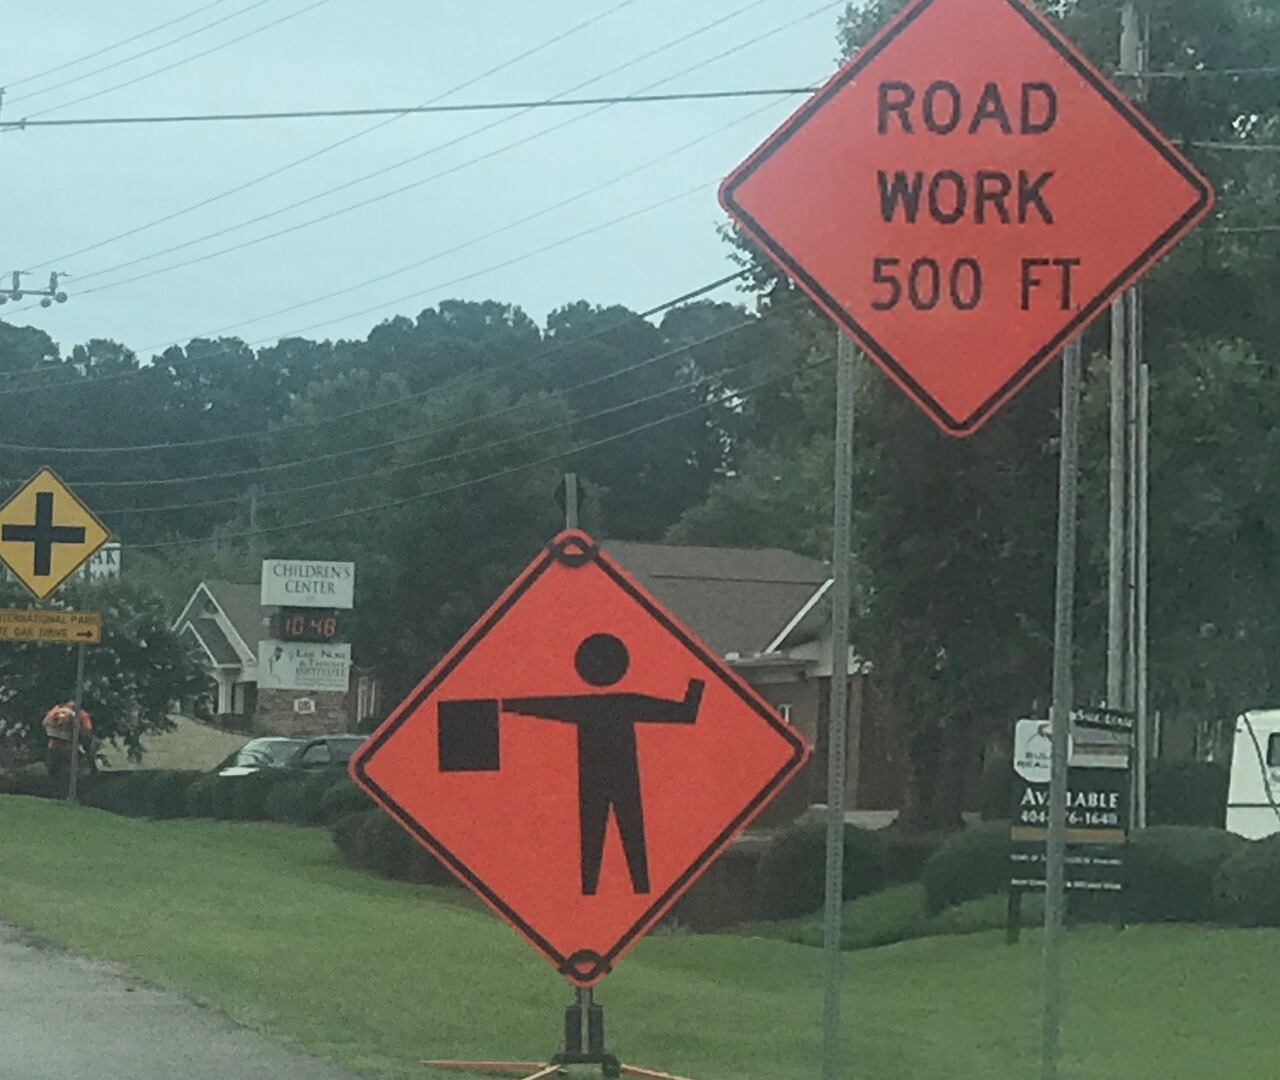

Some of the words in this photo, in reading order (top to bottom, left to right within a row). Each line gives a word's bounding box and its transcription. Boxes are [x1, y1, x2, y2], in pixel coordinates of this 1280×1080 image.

[876, 81, 1058, 136] ROAD
[876, 169, 1055, 225] WORK
[870, 257, 983, 311] 500
[1020, 258, 1081, 311] FT
[273, 563, 351, 578] CHILDREN'S
[285, 580, 336, 594] CENTER
[1020, 787, 1120, 809] AVLABLE
